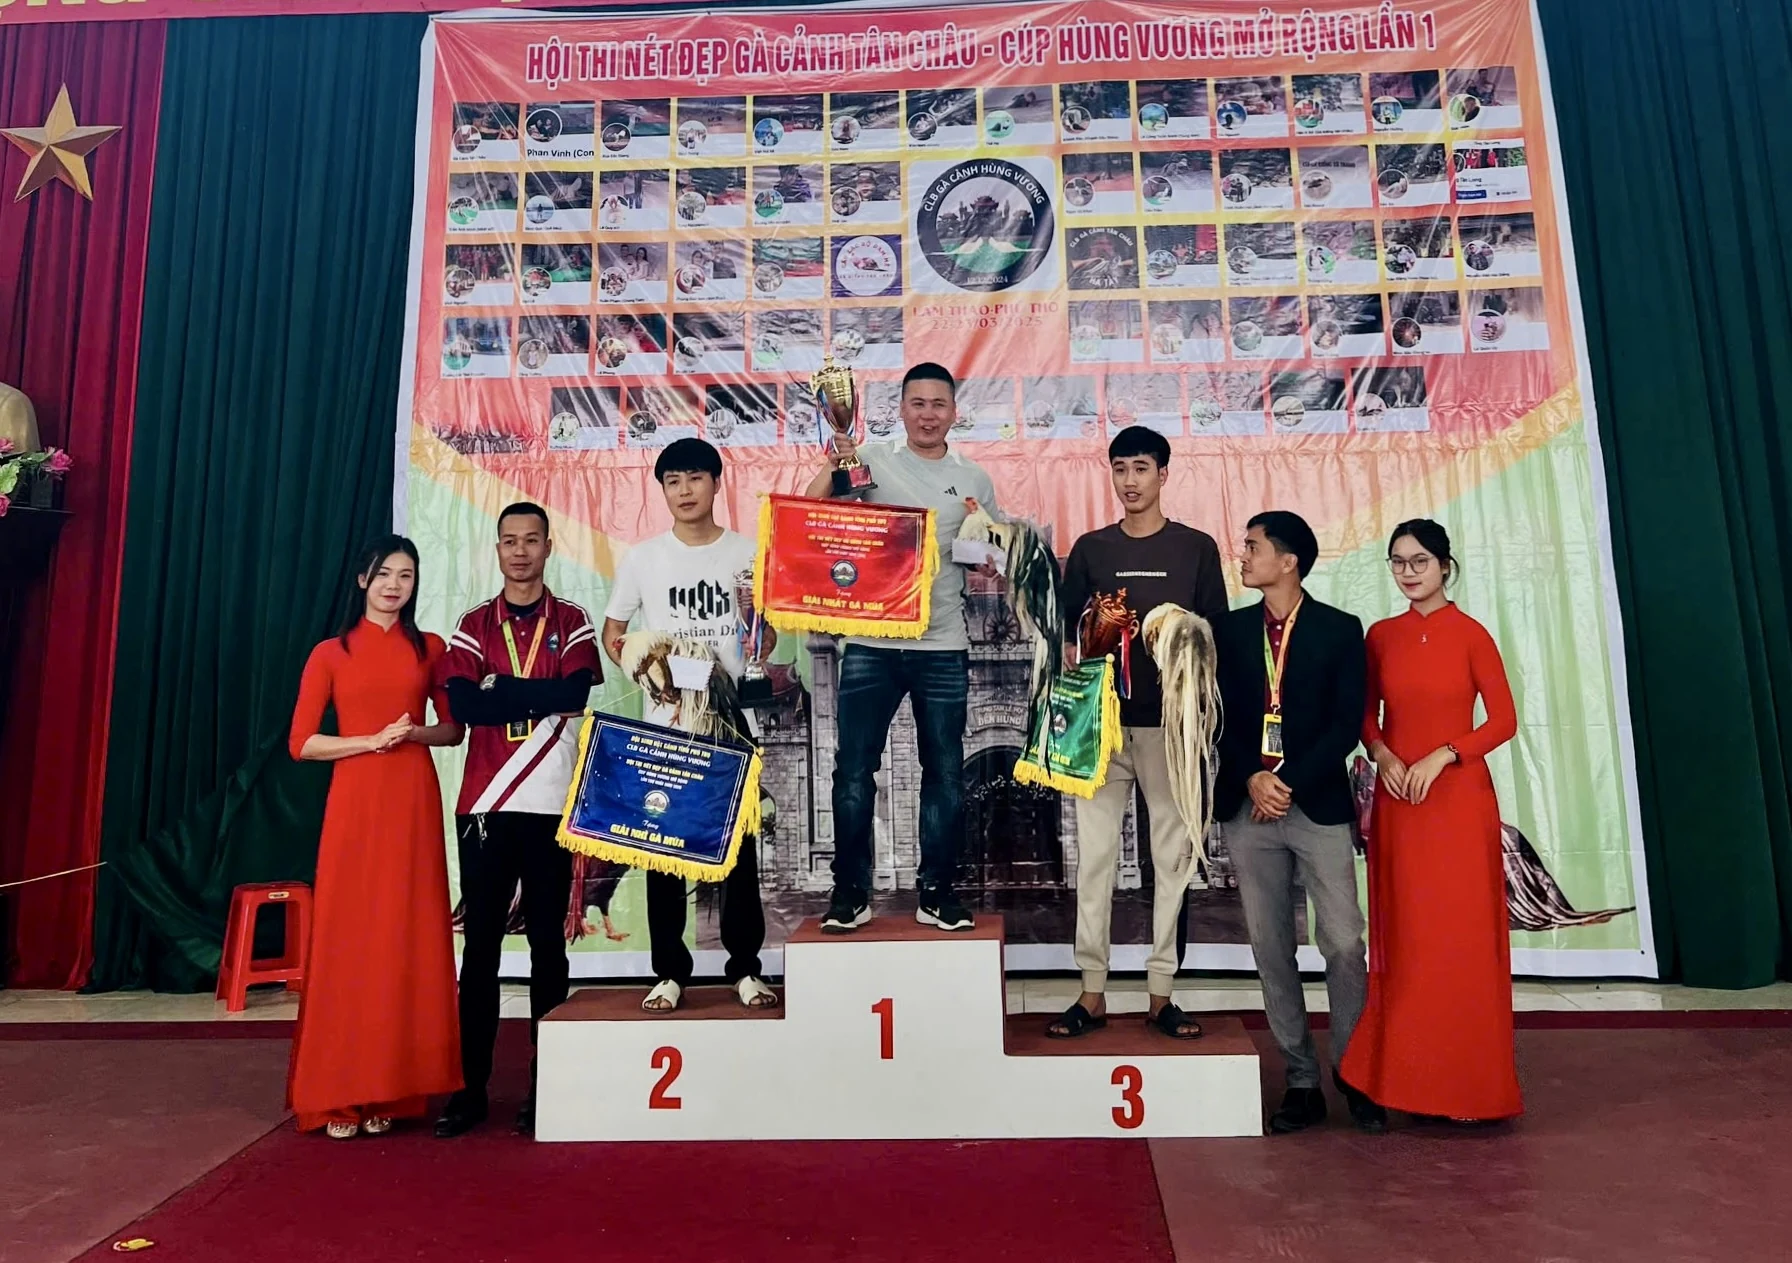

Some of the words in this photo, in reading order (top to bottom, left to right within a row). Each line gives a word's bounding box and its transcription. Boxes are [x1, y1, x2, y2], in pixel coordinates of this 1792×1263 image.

[526, 36, 571, 89] HỘI
[576, 42, 618, 80] THI
[622, 33, 674, 79] NÉT
[677, 38, 728, 86] ĐẸP
[733, 29, 769, 76] GÀ
[773, 24, 846, 75] CẢNH
[849, 24, 901, 72] TÂN
[905, 23, 978, 71] CHÂU
[983, 44, 995, 56] -
[999, 21, 1051, 68] CÚP
[1057, 17, 1131, 64] HÙNG
[1135, 16, 1228, 61] VƯƠNG
[1231, 7, 1275, 57] MỞ
[1280, 8, 1358, 63] RỘNG
[1361, 1, 1416, 51] LẦN
[1420, 10, 1437, 50] 1
[527, 149, 549, 157] Phan
[924, 193, 938, 212] CLB
[936, 180, 951, 195] GÀ
[981, 162, 1012, 177] HÙNG
[670, 626, 716, 640] ristian
[871, 998, 895, 1060] 1
[649, 1046, 683, 1110] 2
[1110, 1065, 1145, 1129] 3
